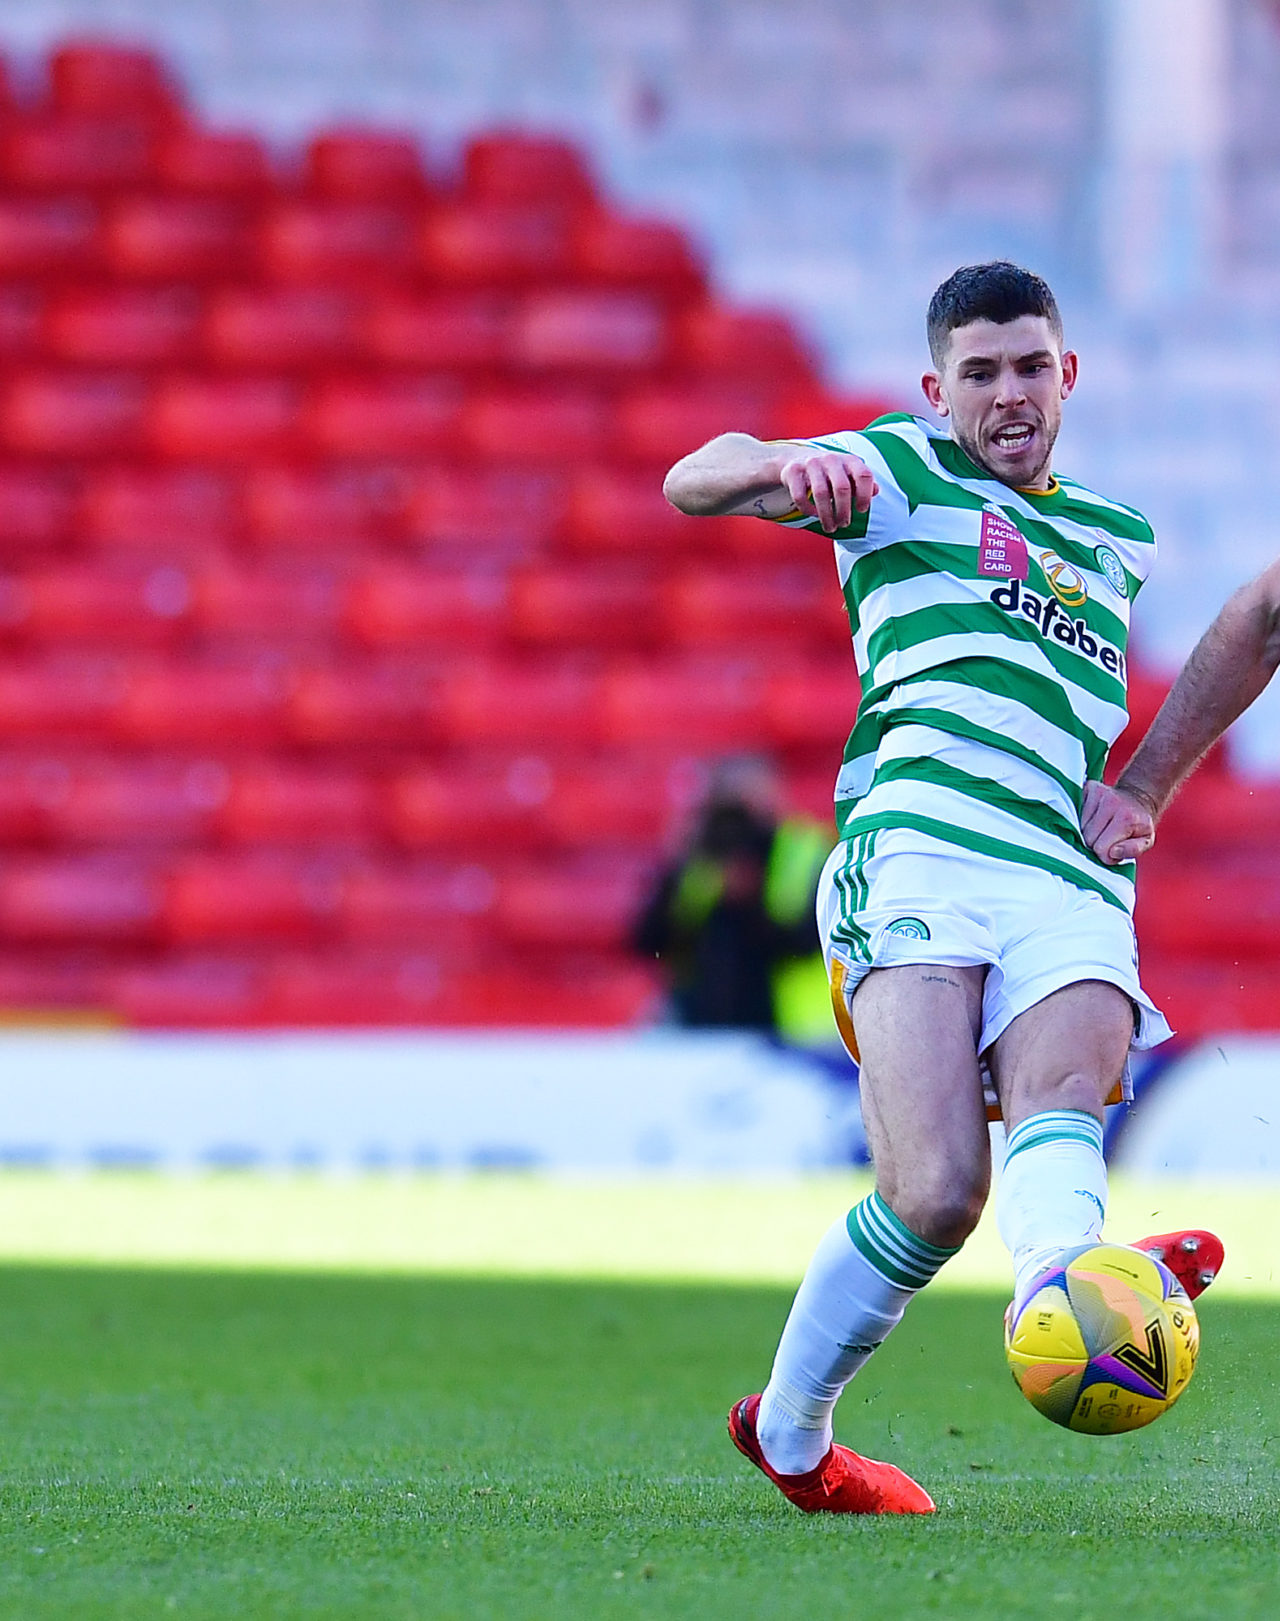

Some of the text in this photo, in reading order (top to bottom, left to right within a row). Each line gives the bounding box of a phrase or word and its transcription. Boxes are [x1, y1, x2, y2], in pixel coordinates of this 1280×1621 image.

[987, 517, 1014, 532] SHOW
[986, 527, 1021, 543] RACISM
[986, 537, 1006, 548] THE
[985, 549, 1006, 559] RED
[984, 562, 1012, 572] CARD
